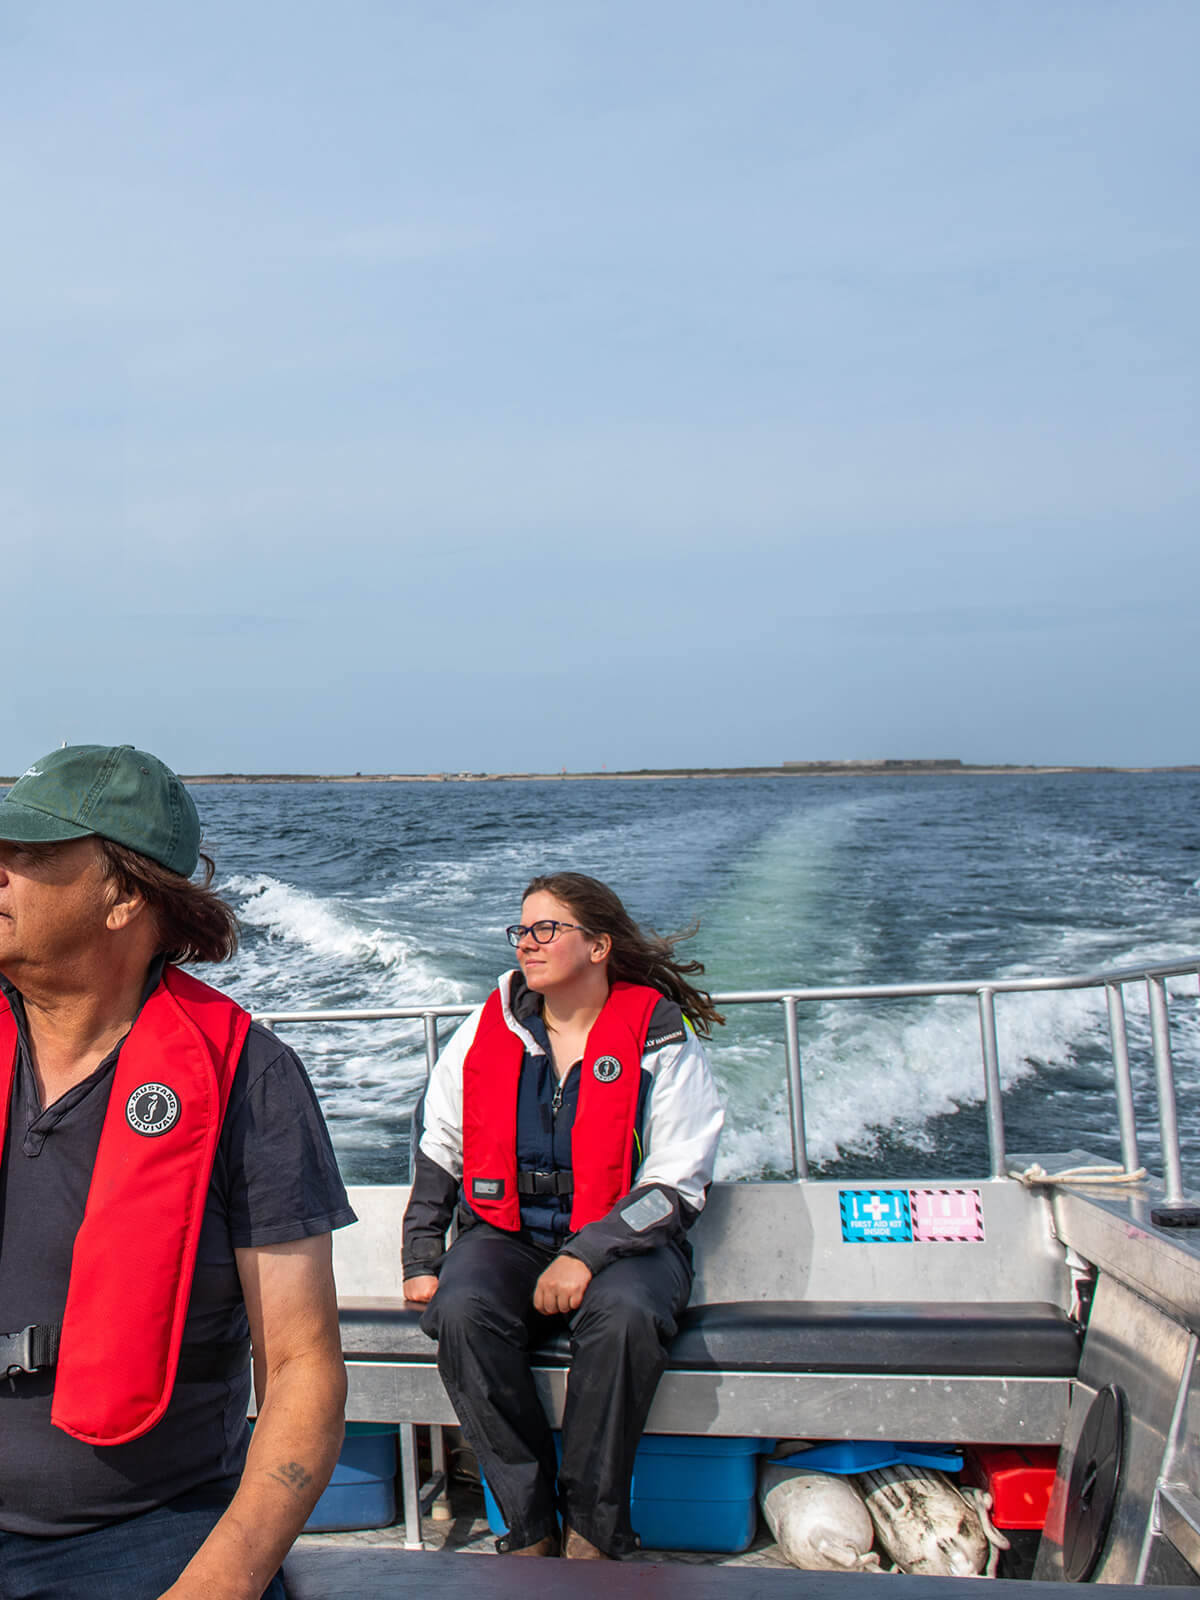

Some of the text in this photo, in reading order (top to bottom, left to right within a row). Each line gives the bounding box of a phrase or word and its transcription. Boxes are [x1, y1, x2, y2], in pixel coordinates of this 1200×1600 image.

[132, 1085, 176, 1109] MUSTANG
[128, 1107, 174, 1131] SURVIVAL
[851, 1219, 902, 1228] FIRST AID KIT
[864, 1228, 890, 1236] INSIDE
